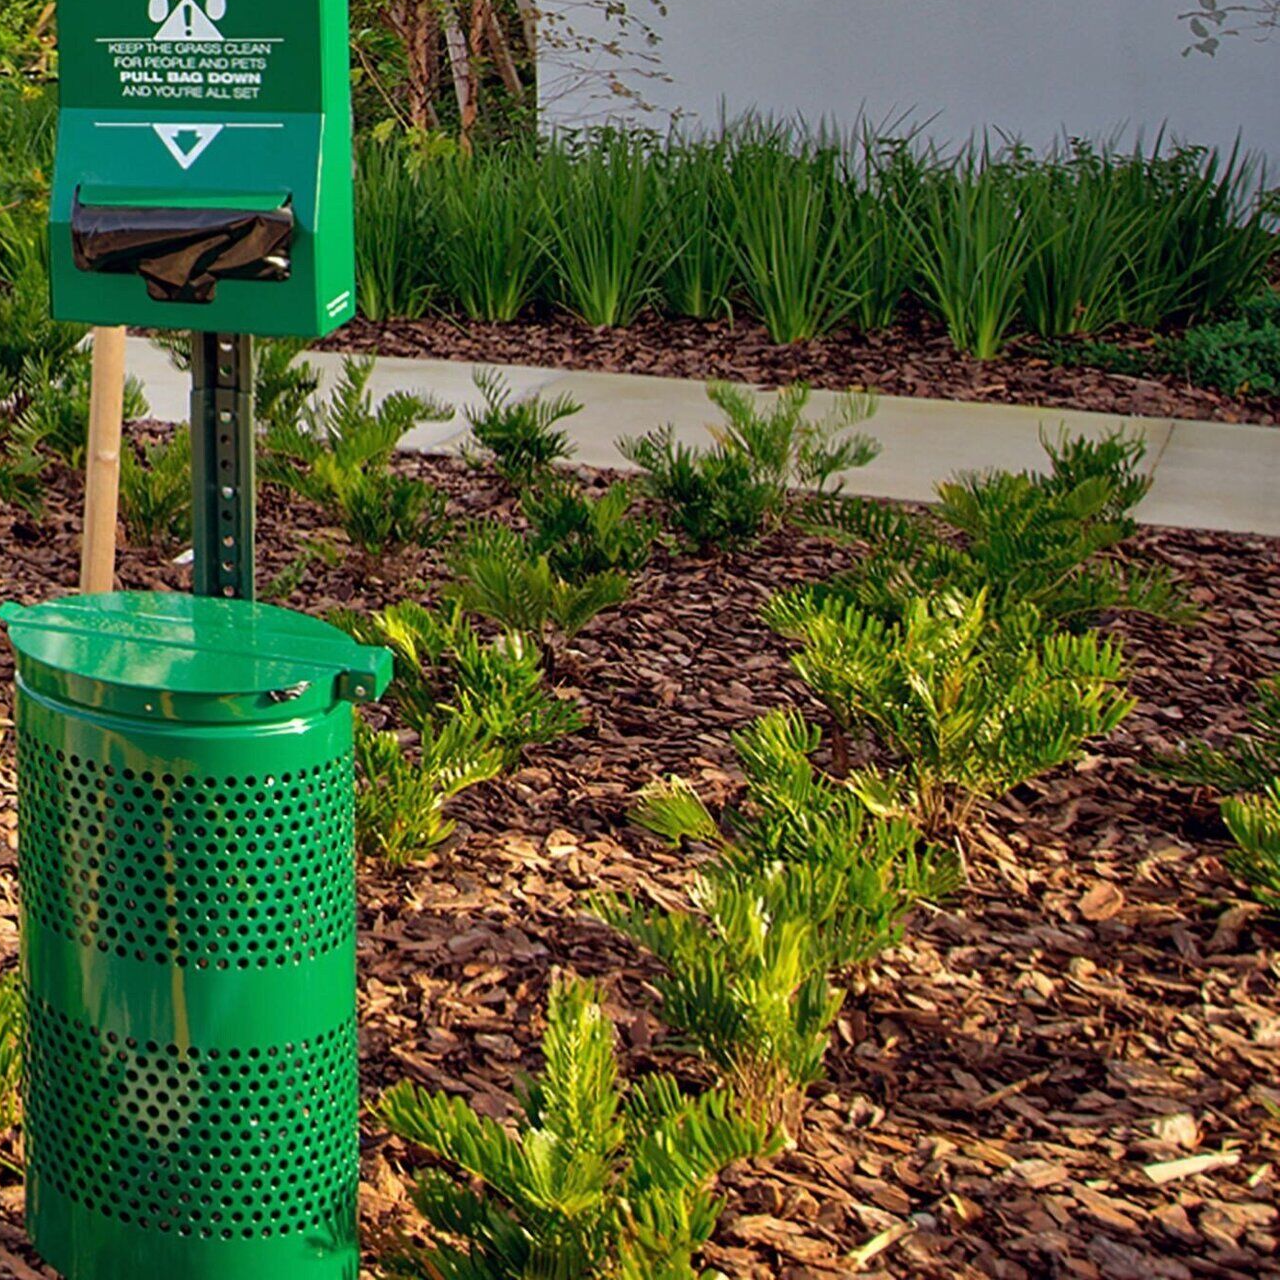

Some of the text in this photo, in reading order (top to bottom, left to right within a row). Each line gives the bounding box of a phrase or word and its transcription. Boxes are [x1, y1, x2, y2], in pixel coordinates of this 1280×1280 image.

[108, 43, 271, 55] KEEP THE GRASS CLEAN
[113, 57, 267, 70] FOR PEOPLE AND PETS
[120, 72, 261, 84] PULL BAG DOWN
[122, 86, 260, 99] AND YOU'RE ALL SET
